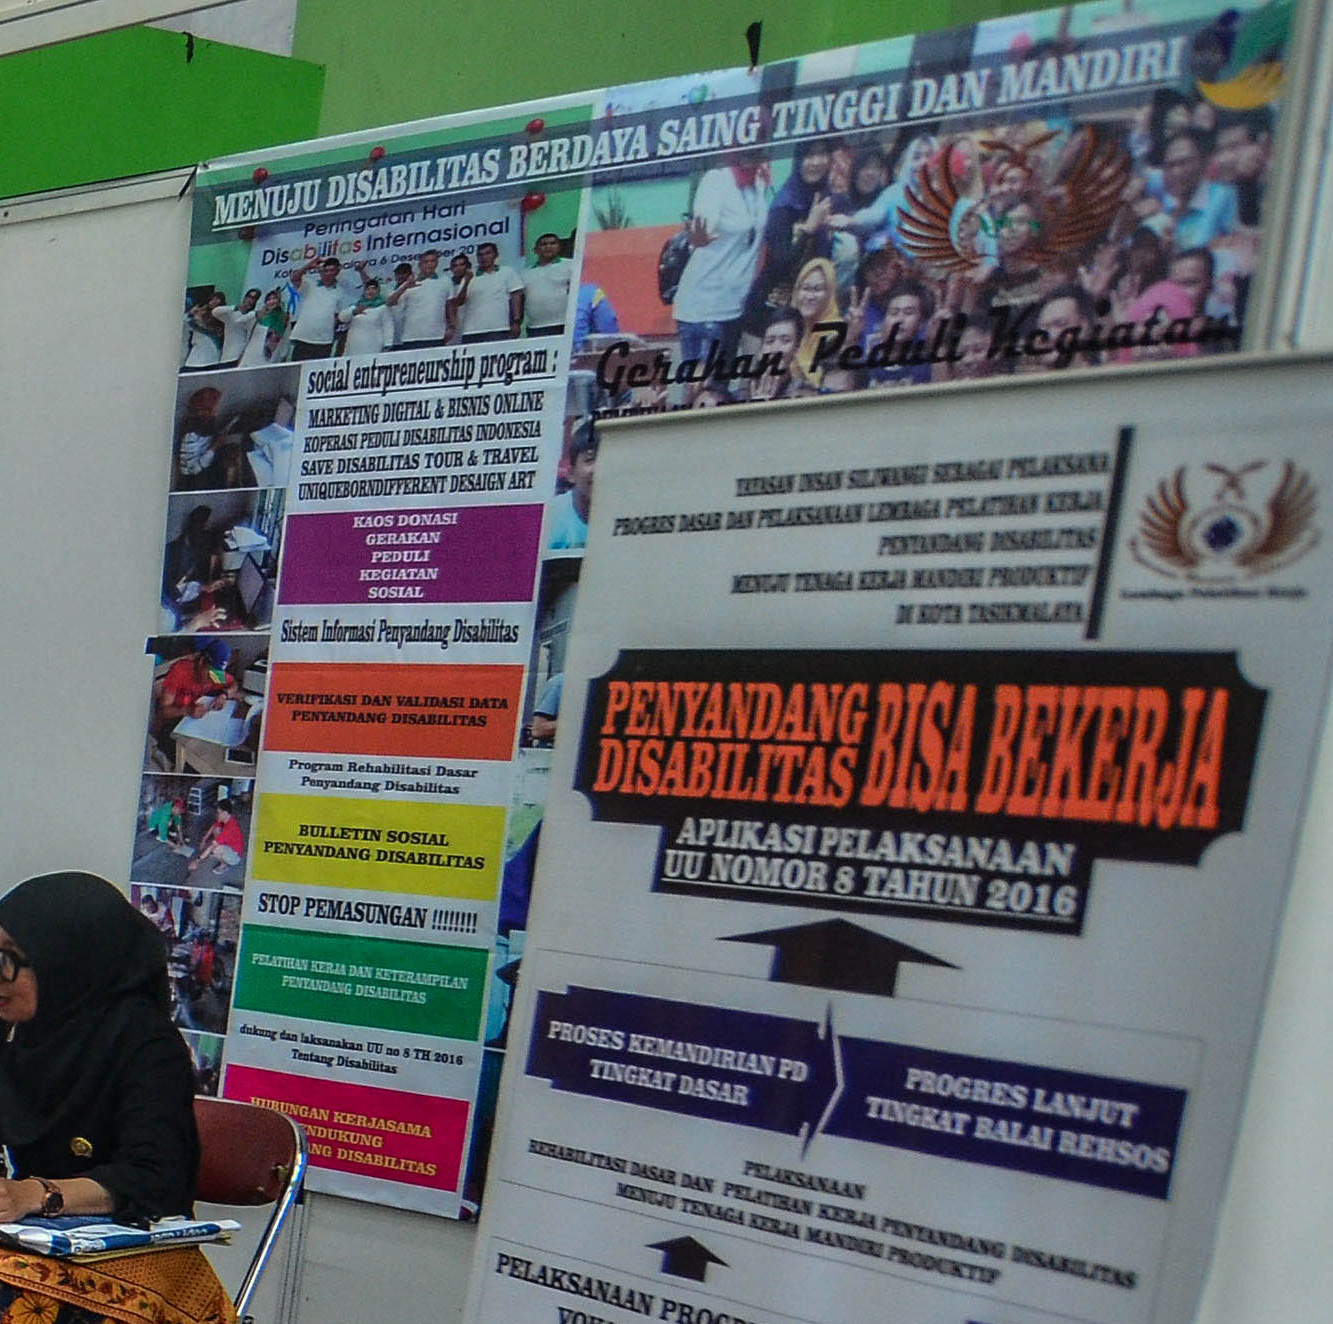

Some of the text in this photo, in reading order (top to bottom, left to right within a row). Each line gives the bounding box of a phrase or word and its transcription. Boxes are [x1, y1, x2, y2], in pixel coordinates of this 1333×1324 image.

[213, 36, 1190, 226] MENUJU DISABILITAS BERDAYA SAING TINGGI DAN MANDIRI
[304, 203, 466, 237] Peringatan Hari
[261, 217, 510, 266] Disabilitas Internasional
[307, 350, 547, 394] social program
[308, 391, 545, 428] MARKETING DIGITAL & BISNIS ONLINE
[303, 421, 542, 454] KOPERASI PEDULI DISABILITAS INDONESIA
[301, 446, 539, 477] SAVE DISABILITAS TOUR & TRAVEL
[509, 471, 536, 490] ART
[353, 513, 459, 528] KAOS DONASI
[366, 531, 441, 546] GERAKAN
[371, 550, 431, 563] PEDULI
[359, 568, 438, 582] KEGIATAN
[368, 586, 424, 599] SOSIAL
[281, 619, 519, 650] Sistem Informasi Penyandang Disabilitas
[277, 693, 509, 710] VERIFIKASI DAN VALIDASI DATA
[291, 710, 487, 728] PENYANDANG DISABILITAS
[288, 759, 478, 779] Program Rehabilitasi Dasar
[600, 680, 1229, 832] PENYANDANG BISA BEKERJA
[301, 776, 461, 795] Penyandang Disabilitas
[591, 738, 861, 809] DISABILITAS
[299, 823, 450, 847] BULLETIN SOSIAL
[675, 816, 1077, 878] APLIKASI PELAKSANAAN
[263, 841, 485, 870] PENYANDANG DISABILITAS
[662, 848, 1078, 918] UU NOMOR 8 TAHUN 2016
[258, 893, 300, 917] STOP
[304, 897, 428, 930] PEMASUNGAN
[252, 953, 468, 990] PELATIHAN KERJA DAN KETERAMPILAN
[281, 975, 427, 1005] PENYANDANG DISABILITAS
[240, 1024, 463, 1066] dukung dan laksanakan UU TH 2016
[291, 1048, 398, 1075] Tentang Disabilitas
[547, 1020, 809, 1083] PROSES KEMANDIRIAN PD
[589, 1058, 750, 1107] TINGKAT DASAR
[904, 1067, 1139, 1131] PROGRES LANJUT
[334, 1111, 433, 1138] KERJASAMA
[866, 1096, 1171, 1174] TINGKAT BALAI REHSOS
[337, 1147, 437, 1176] DISABILITAS
[528, 1138, 627, 1176] REHABILITASI
[743, 1159, 866, 1200] PELAKSANAAN
[496, 1252, 654, 1318] PELAKSANAAN
